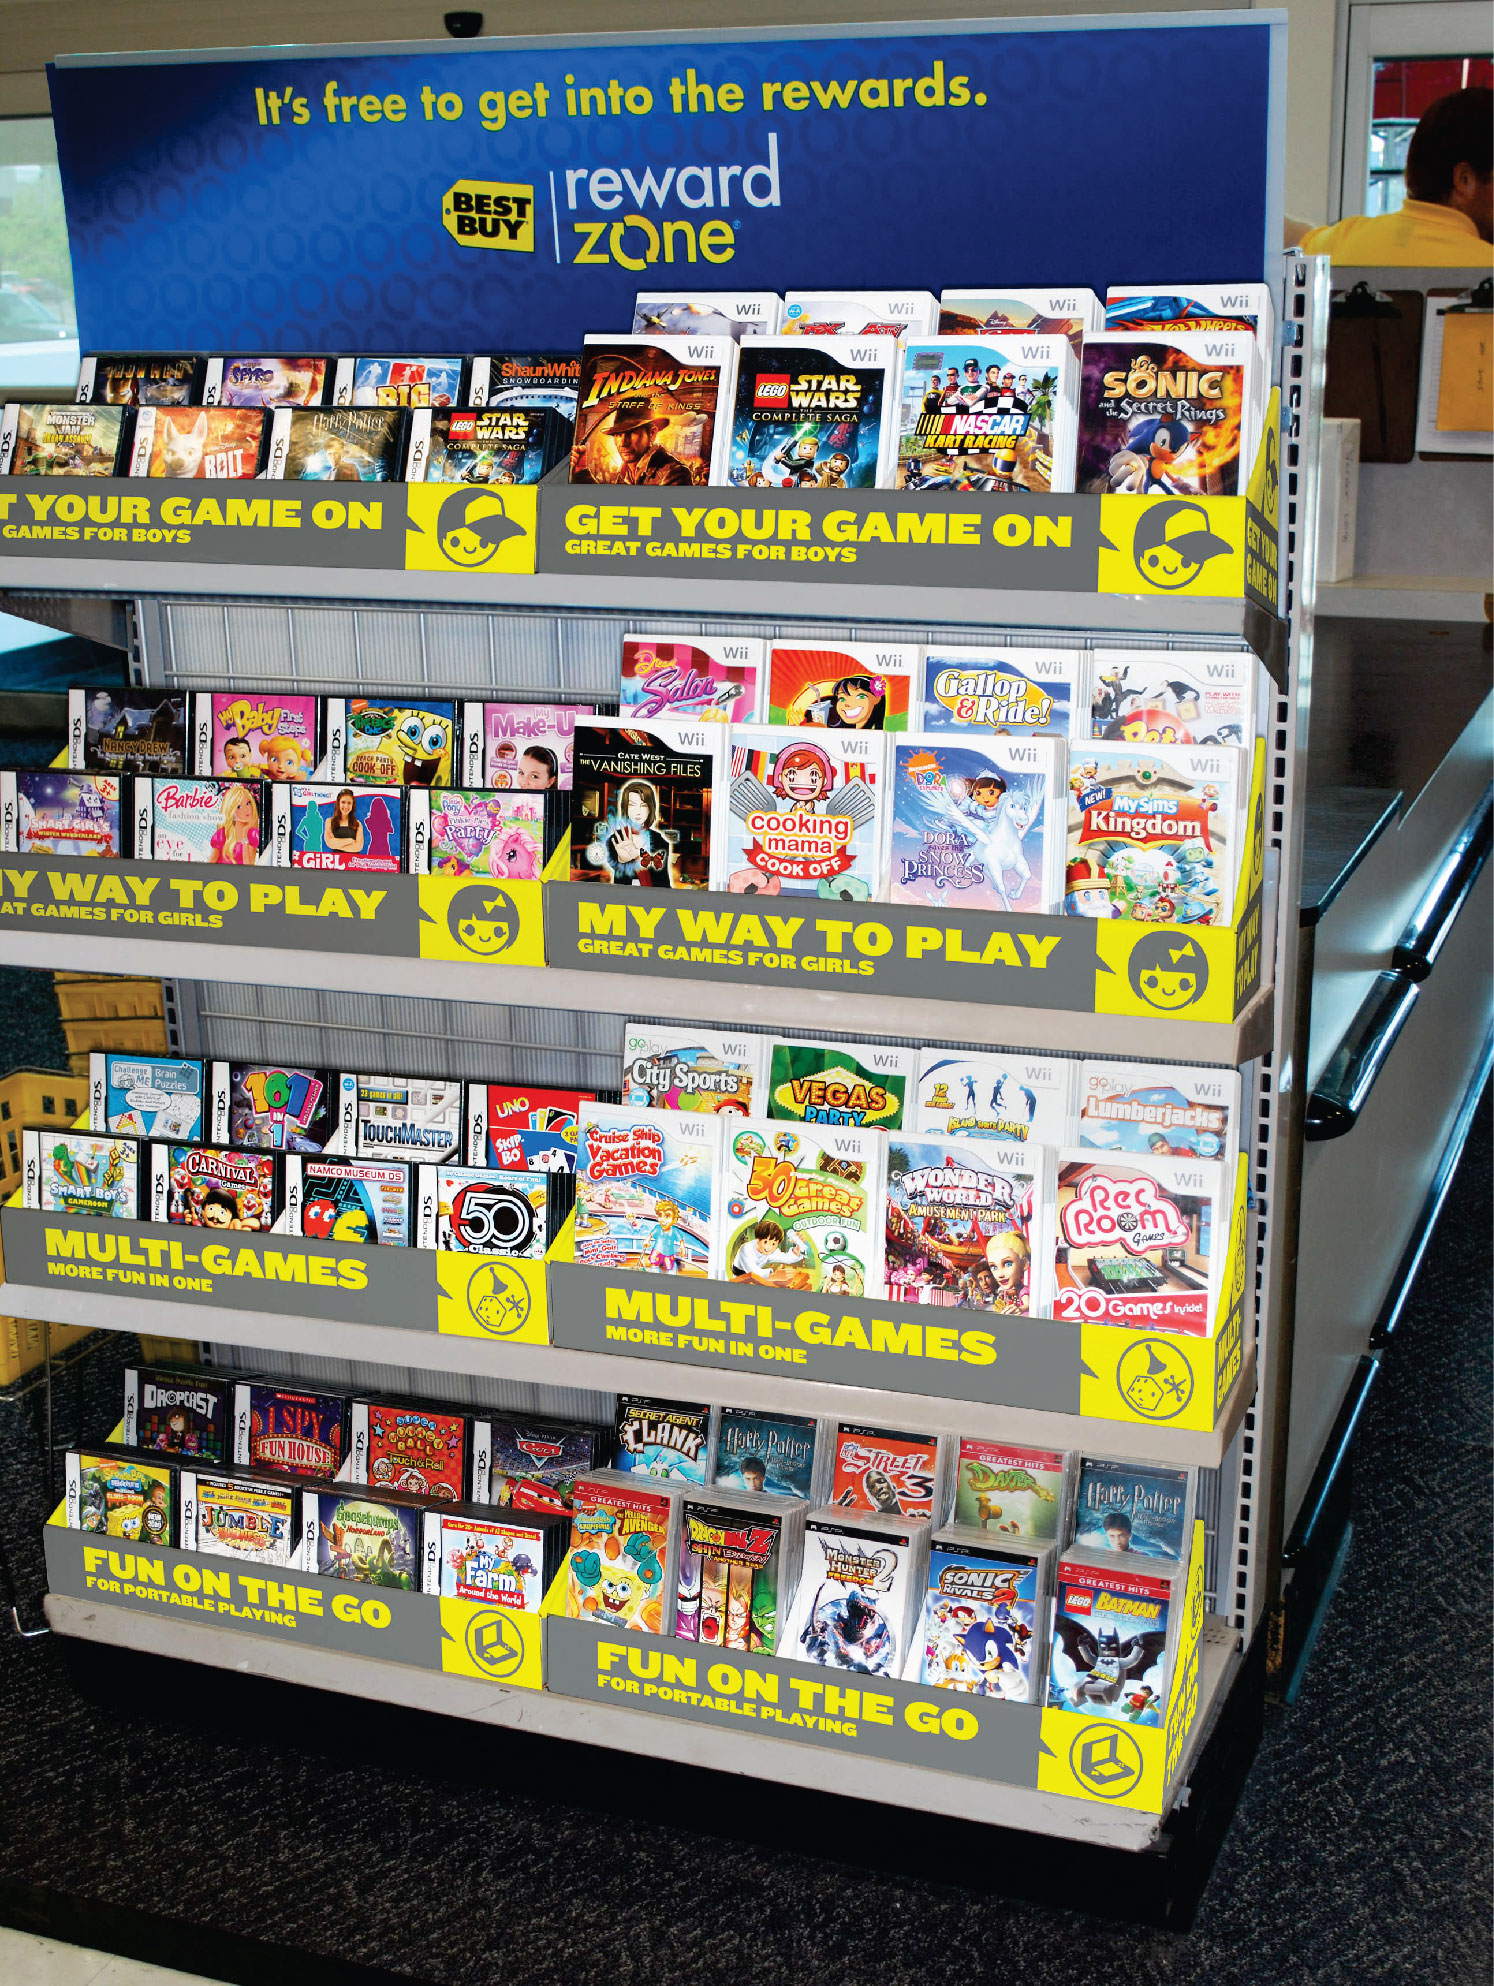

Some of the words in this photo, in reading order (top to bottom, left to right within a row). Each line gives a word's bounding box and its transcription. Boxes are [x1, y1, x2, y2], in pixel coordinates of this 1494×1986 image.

[256, 87, 309, 124] It's
[324, 81, 405, 122] free
[421, 87, 462, 120] to
[479, 83, 549, 130] get
[566, 75, 652, 115] into
[670, 69, 744, 112] the
[763, 61, 987, 110] rewards.
[566, 133, 780, 209] reward
[453, 192, 531, 216] BEST
[457, 215, 526, 240] BUY
[573, 214, 734, 271] zone
[736, 303, 760, 315] Wii
[1049, 298, 1076, 312] Wii
[1220, 295, 1249, 308] Wii
[230, 364, 274, 385] SPYRO
[791, 374, 861, 391] STAR
[1104, 370, 1224, 399] SONIC
[582, 370, 672, 408] INDIANA
[670, 369, 715, 390] JONES
[757, 383, 788, 397] LEGO
[608, 401, 644, 410] STAFF
[648, 401, 662, 410] OF
[668, 401, 700, 410] KINGS
[791, 392, 861, 408] WARS
[1120, 400, 1175, 421] Secret
[1175, 401, 1225, 421] Rings
[46, 415, 95, 426] MONSTER
[452, 420, 474, 432] LEGO
[476, 412, 529, 426] STAR
[752, 412, 822, 422] COMPLETE
[826, 413, 858, 423] SAGA
[949, 413, 1025, 434] NASCAR
[57, 426, 81, 434] JAM
[476, 426, 528, 439] WARS
[923, 434, 972, 449] KART
[974, 434, 1016, 448] RACING
[204, 449, 243, 478] BOLT
[25, 494, 151, 524] YOUR
[160, 497, 301, 528] GAME
[312, 500, 382, 529] ON
[2, 525, 80, 540] GAMES
[84, 527, 128, 541] FOR
[132, 528, 191, 543] BOYS
[565, 505, 662, 536] GET
[670, 508, 811, 540] YOUR
[822, 510, 982, 544] GAME
[993, 514, 1072, 547] ON
[565, 539, 641, 555] GREAT
[646, 542, 732, 559] GAMES
[737, 544, 785, 560] FOR
[791, 546, 857, 563] BOYS
[723, 647, 748, 659] Wii
[936, 671, 1028, 705] Gallop
[280, 709, 303, 723] First
[957, 699, 977, 721] &
[977, 699, 1053, 726] Ride!
[278, 722, 306, 735] Steps
[103, 738, 138, 752] NANCY
[139, 740, 170, 753] DREW
[352, 762, 396, 776] COOK-OFF
[591, 761, 666, 775] VANISHING
[670, 763, 701, 777] FILES
[156, 786, 218, 812] Barbie
[1085, 789, 1106, 806] NEW!
[1112, 797, 1178, 815] MySims
[750, 813, 850, 838] cooking
[1090, 811, 1200, 841] Kingdom
[768, 837, 832, 854] mama
[755, 856, 804, 876] COOK
[809, 857, 842, 874] OFF
[47, 872, 160, 905] WAY
[170, 879, 238, 911] TO
[249, 883, 387, 920] PLAY
[31, 903, 106, 920] GAMES
[111, 909, 154, 923] FOR
[158, 912, 223, 928] GIRLS
[578, 902, 667, 938] MY
[676, 909, 805, 949] WAY
[816, 919, 893, 956] TO
[906, 926, 1062, 968] PLAY
[577, 939, 653, 957] GREAT
[658, 945, 744, 965] GAMES
[748, 952, 797, 969] FOR
[801, 956, 874, 975] GIRLS
[723, 1043, 747, 1057] Wii
[115, 1065, 147, 1075] Challenge
[155, 1069, 176, 1079] Brain
[632, 1060, 670, 1091] City
[674, 1063, 737, 1092] Sports
[155, 1080, 186, 1090] Puzzles
[246, 1071, 309, 1112] 101
[792, 1080, 886, 1108] VEGAS
[496, 1097, 530, 1118] UNO
[805, 1106, 865, 1126] PARTY
[1089, 1096, 1222, 1128] Lumberjacks
[588, 1142, 662, 1163] Vacation
[188, 1155, 256, 1183] CARNIVAL
[310, 1166, 342, 1178] NAMCO
[344, 1168, 386, 1180] MUSEUM
[388, 1172, 402, 1182] DS
[588, 1158, 659, 1178] Games
[901, 1168, 1014, 1200] WONDER
[926, 1187, 993, 1206] WORLD
[909, 1204, 976, 1222] AMUSEMENT
[978, 1209, 1006, 1222] PARK
[45, 1228, 368, 1290] MULTI-GAMES
[47, 1262, 103, 1279] MORE
[106, 1269, 146, 1285] FUN
[149, 1273, 169, 1288] IN
[173, 1276, 212, 1292] ONE
[1061, 1292, 1105, 1318] 20
[1108, 1299, 1172, 1317] Games
[1174, 1301, 1203, 1314] Inside!
[606, 1288, 1001, 1365] MULTI-GAMES
[606, 1325, 673, 1347] MORE
[678, 1334, 725, 1353] FUN
[730, 1341, 753, 1357] IN
[759, 1345, 807, 1364] ONE
[143, 1384, 217, 1419] DROPCAST
[628, 1408, 664, 1421] SECRET
[665, 1414, 699, 1425] AGENT
[623, 1420, 706, 1457] CLANK
[724, 1428, 764, 1458] Harry
[766, 1431, 810, 1461] Potter
[261, 1440, 292, 1458] FUN
[294, 1443, 330, 1464] HOUSE
[979, 1455, 1022, 1466] GREATEST
[1025, 1461, 1045, 1469] HITS
[203, 1506, 285, 1539] JUMBLE
[479, 1555, 496, 1575] My
[83, 1546, 164, 1586] FUN
[173, 1564, 231, 1598] ON
[239, 1576, 323, 1617] THE
[331, 1594, 391, 1628] GO
[465, 1561, 517, 1592] Farm
[944, 1568, 1012, 1587] SONIC
[86, 1576, 121, 1593] FOR
[123, 1584, 215, 1611] PORTABLE
[218, 1602, 296, 1627] PLAYING
[459, 1586, 485, 1598] Around
[487, 1591, 499, 1601] the
[502, 1593, 522, 1605] World
[1067, 1594, 1090, 1607] LEGO
[1095, 1591, 1161, 1619] BATMAN
[596, 1641, 700, 1684] FUN
[706, 1662, 778, 1703] ON
[790, 1678, 894, 1726] THE
[905, 1702, 979, 1740] GO
[598, 1674, 640, 1694] FOR
[644, 1683, 756, 1717] PORTABLE
[760, 1706, 857, 1737] PLAYING
